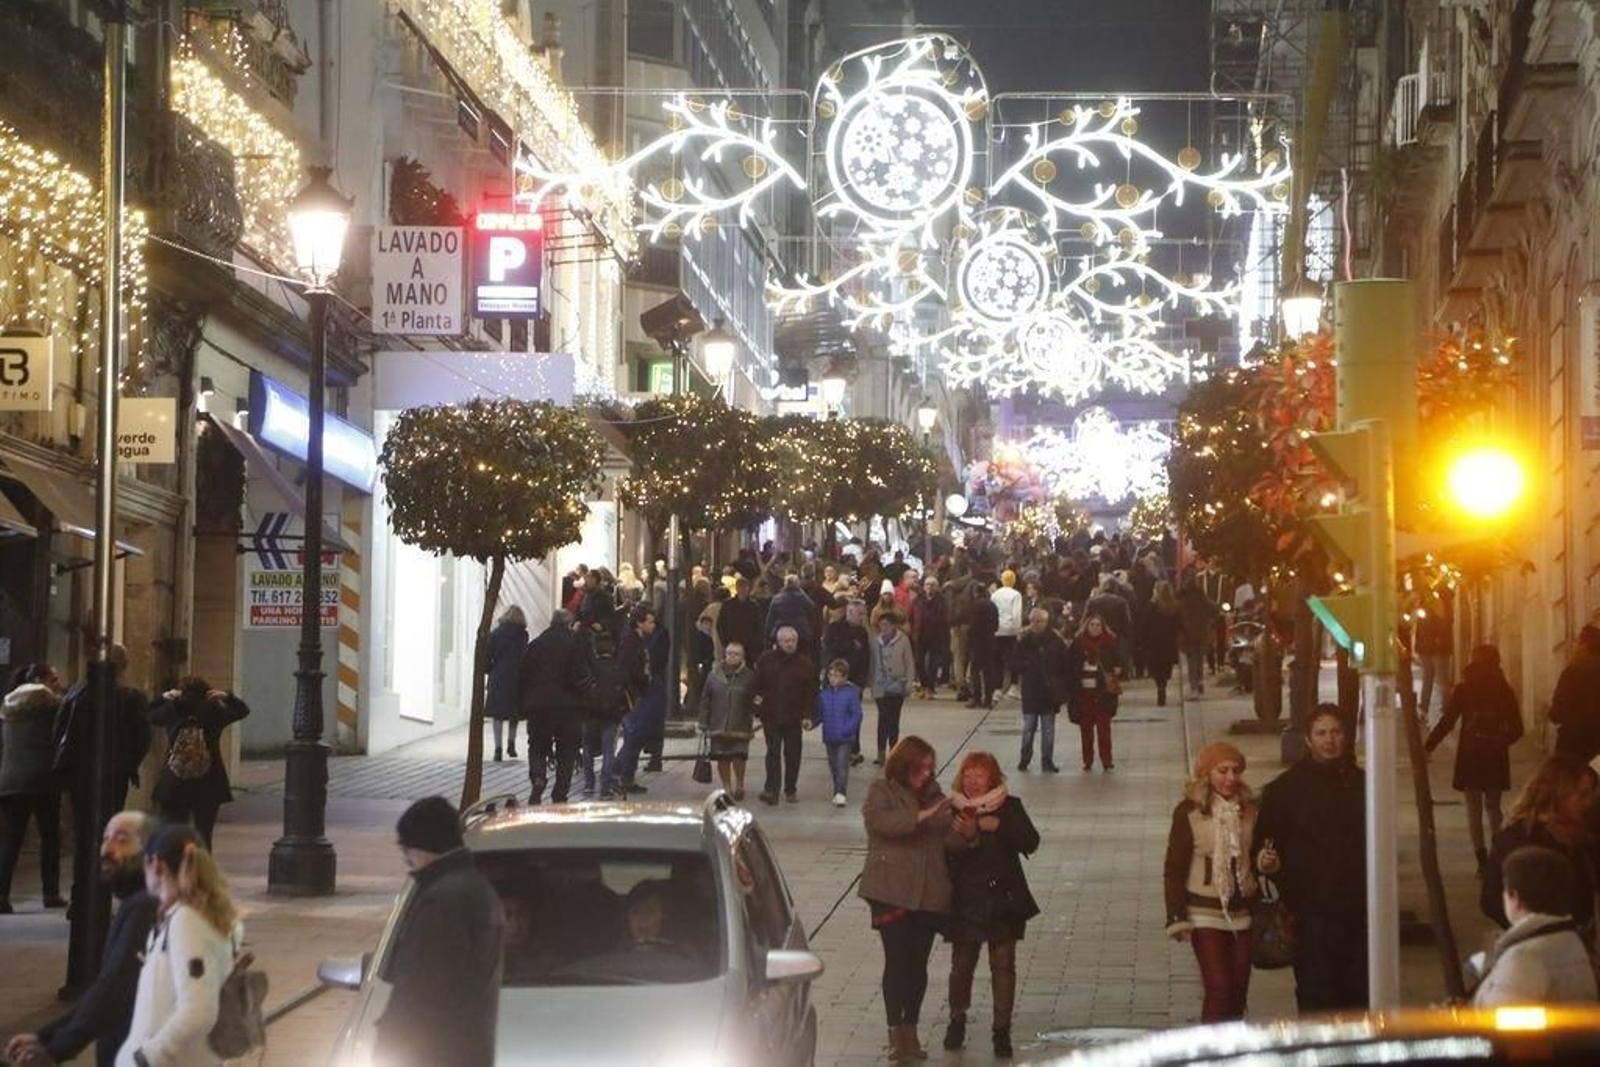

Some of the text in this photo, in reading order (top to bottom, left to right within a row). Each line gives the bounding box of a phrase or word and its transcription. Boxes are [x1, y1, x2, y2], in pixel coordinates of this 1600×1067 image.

[378, 230, 459, 254] LAVADO
[489, 236, 526, 282] P
[411, 256, 425, 279] A
[386, 282, 448, 306] MANO
[401, 310, 453, 329] Planta
[3, 391, 40, 401] TIMO
[251, 574, 293, 586] LAVADO
[271, 590, 291, 603] 617
[260, 606, 282, 615] UNA
[252, 616, 297, 625] PARKING
